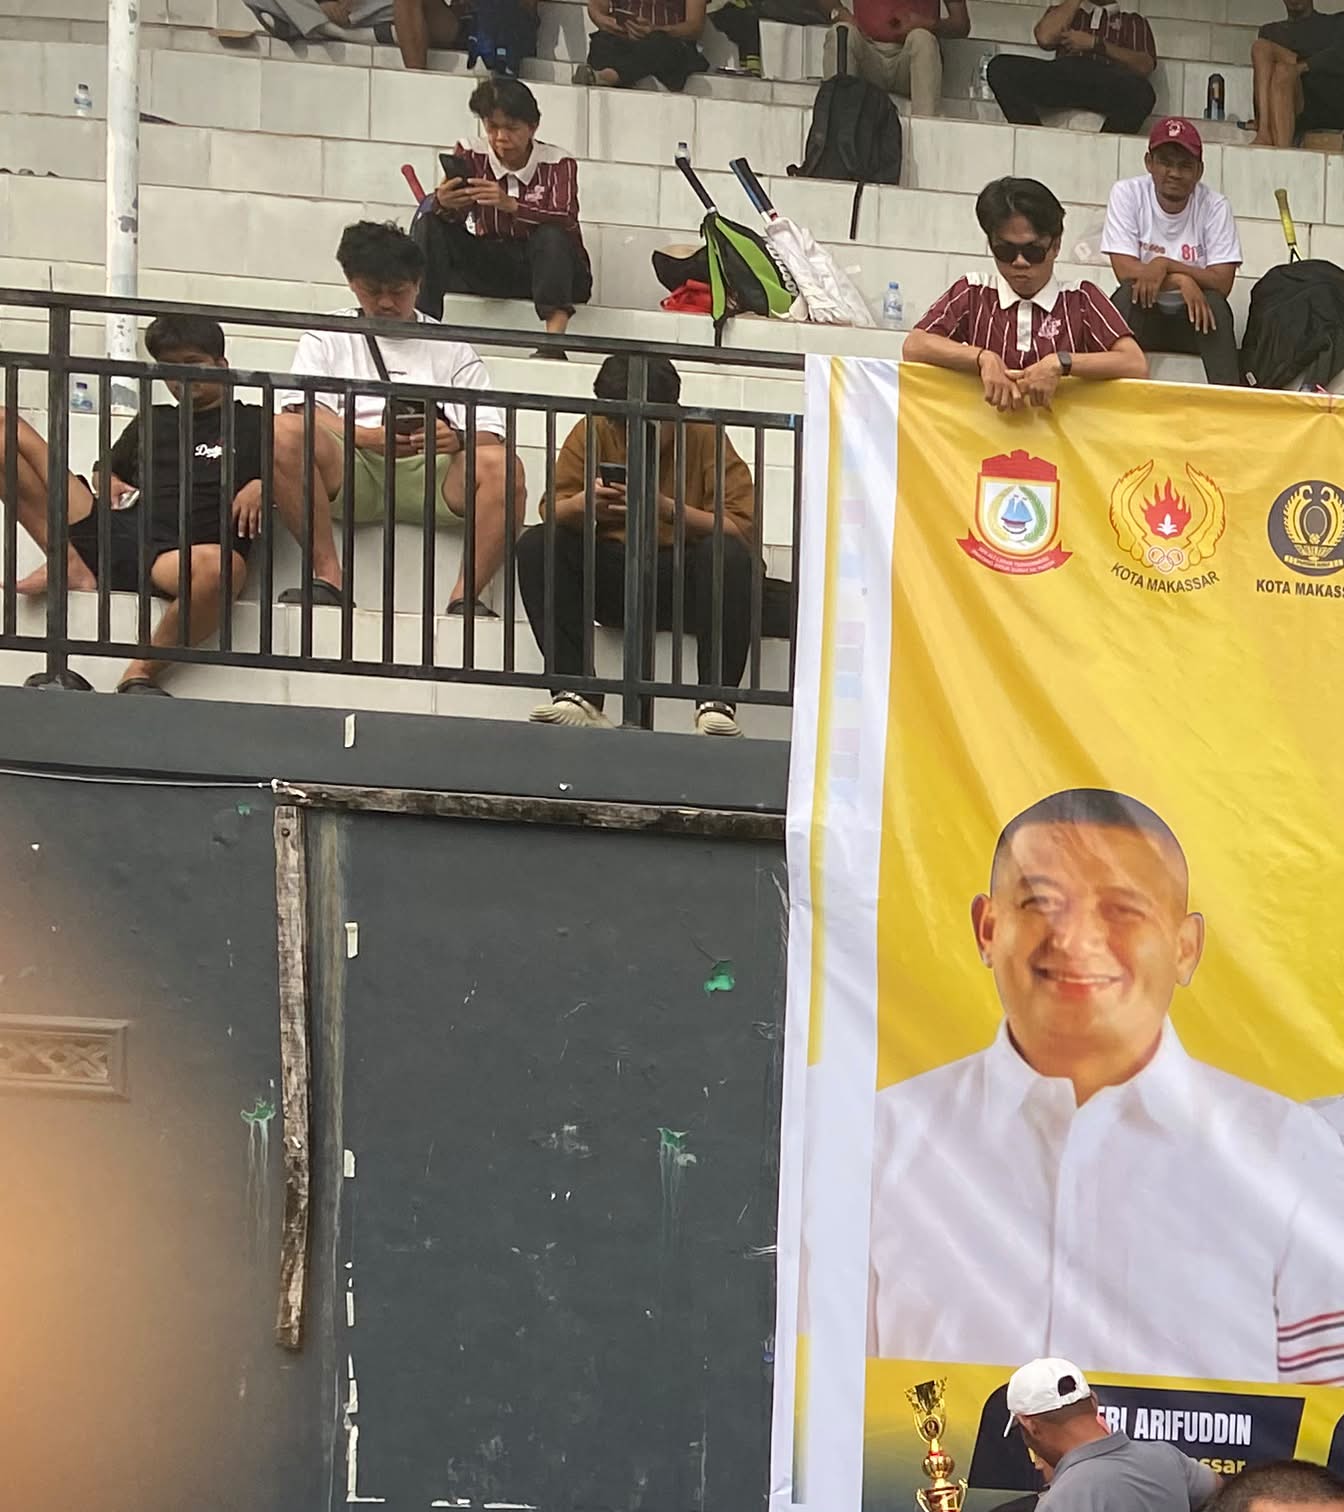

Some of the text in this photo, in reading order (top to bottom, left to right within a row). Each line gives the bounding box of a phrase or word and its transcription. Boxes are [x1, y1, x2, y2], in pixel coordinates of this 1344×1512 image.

[1110, 561, 1220, 593] KOTA MAKASSAR
[1256, 579, 1291, 594] KOTA
[1133, 1407, 1252, 1445] ARIFUDDIN
